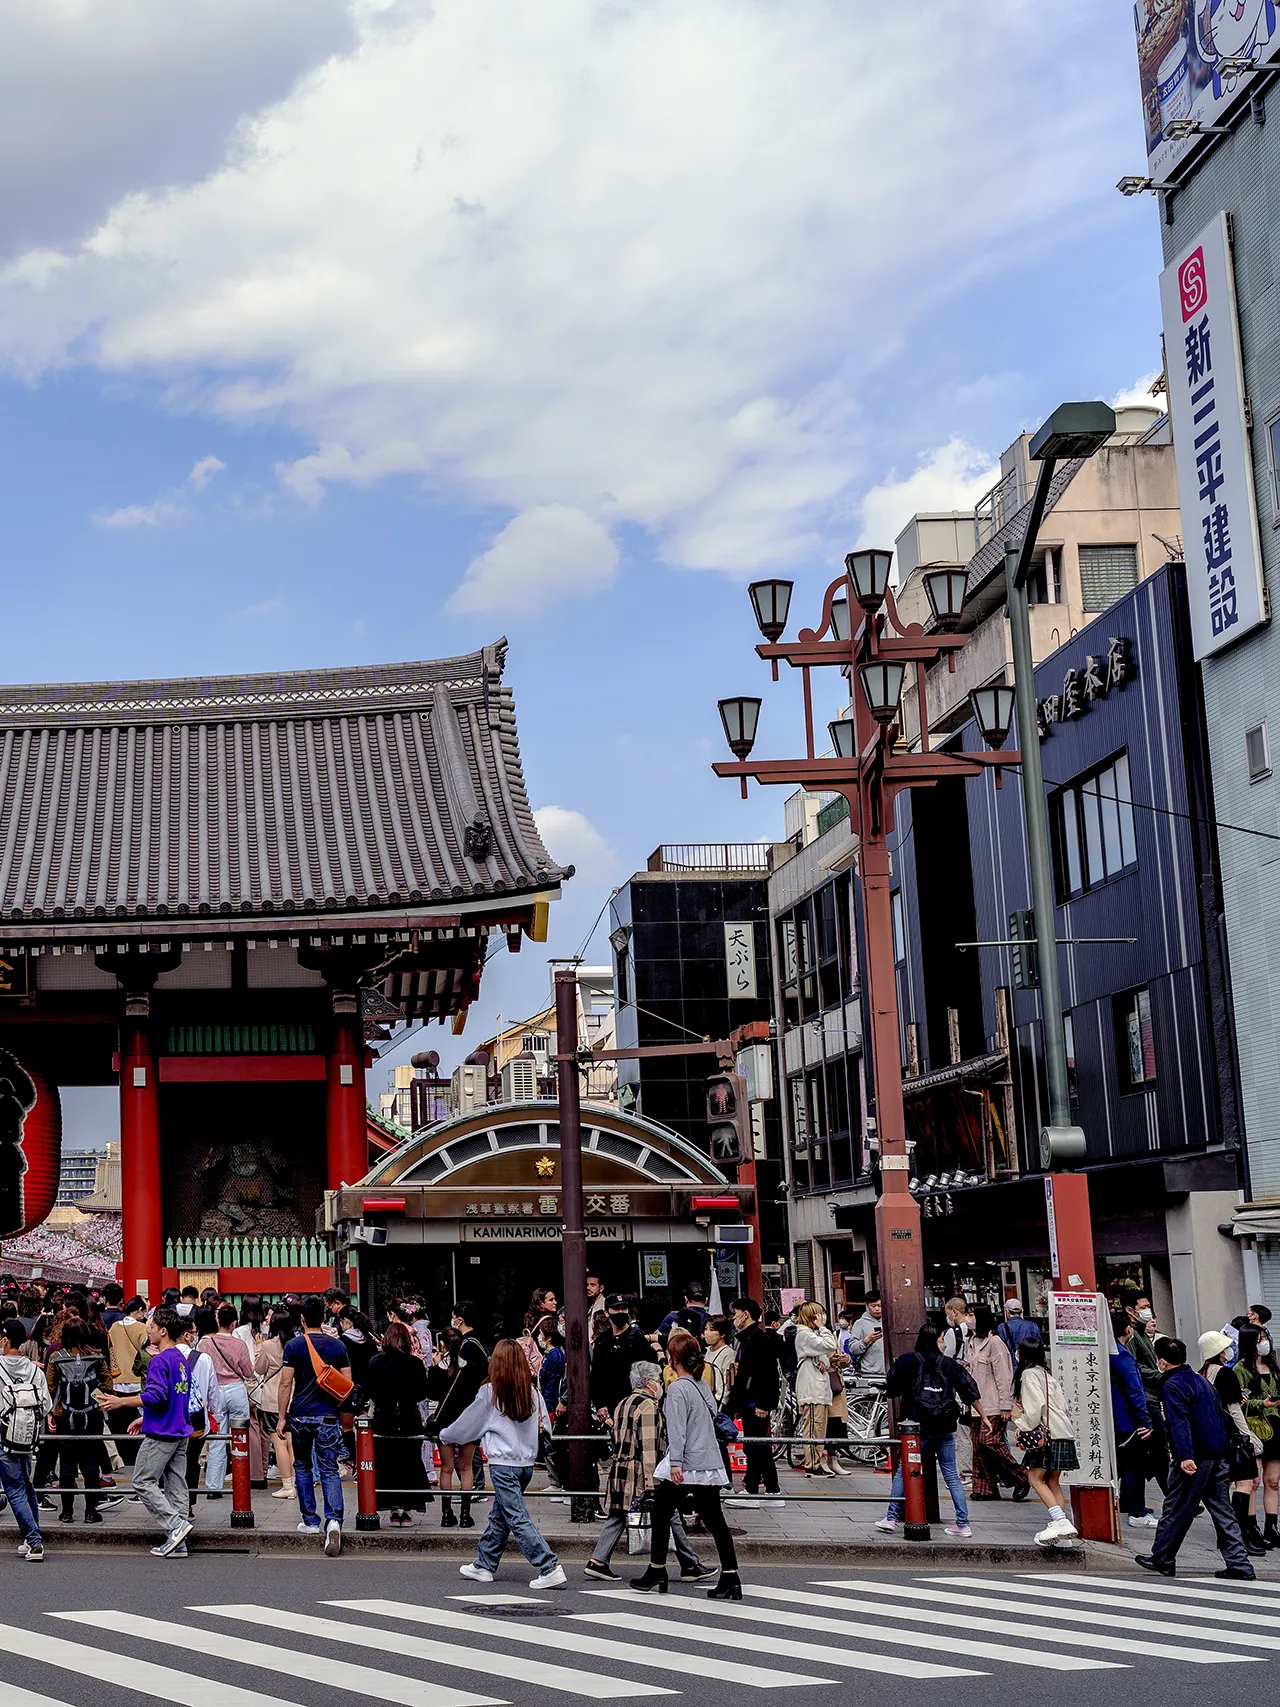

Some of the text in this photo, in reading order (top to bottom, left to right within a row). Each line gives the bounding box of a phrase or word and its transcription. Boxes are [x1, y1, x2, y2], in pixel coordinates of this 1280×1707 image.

[1185, 313, 1239, 637] 新三平建設
[1036, 637, 1126, 735] 田屋本店
[728, 929, 750, 991] 天ぷら
[465, 1194, 631, 1215] 浅草警察署 雷交番
[473, 1227, 617, 1238] KAMINARIMON OBAN
[1085, 1352, 1104, 1480] 東京大空襲資料展
[360, 1460, 373, 1471] 24K
